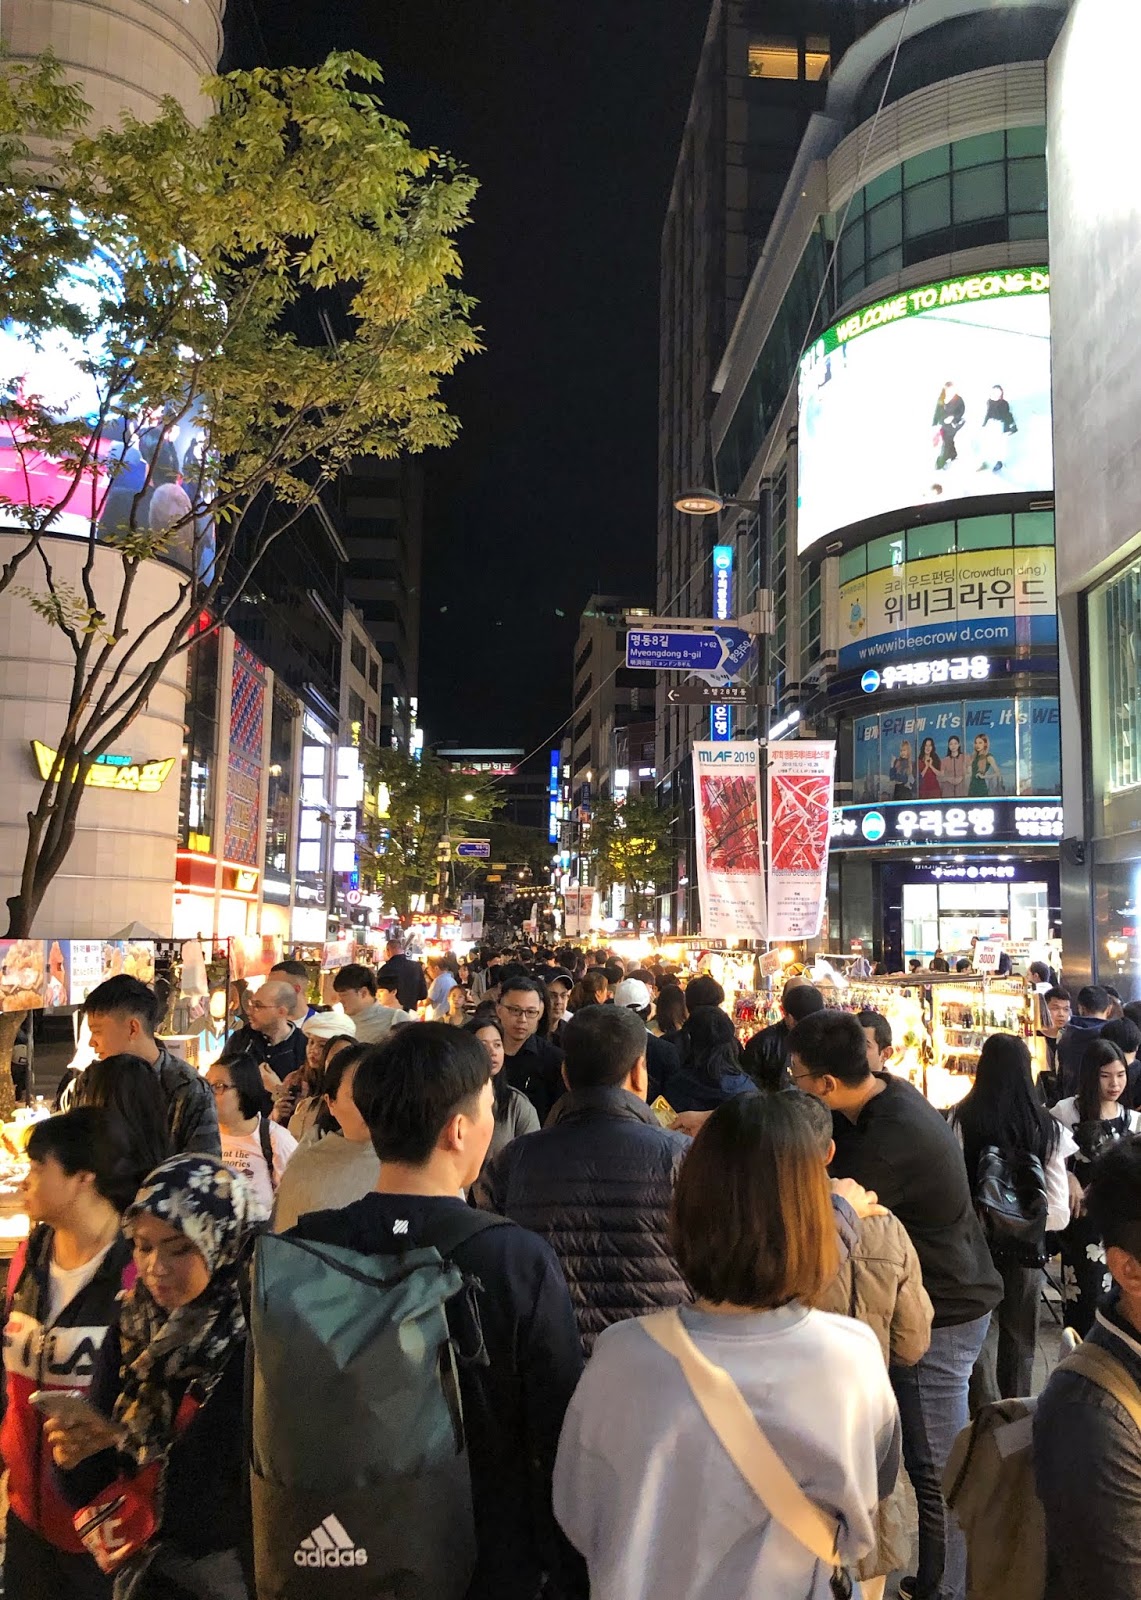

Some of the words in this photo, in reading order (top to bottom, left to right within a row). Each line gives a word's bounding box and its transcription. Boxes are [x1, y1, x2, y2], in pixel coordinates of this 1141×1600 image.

[836, 296, 908, 342] WELCOME
[909, 288, 937, 311] TO
[884, 569, 955, 594] 크라우드펀딩
[884, 580, 1048, 624] 위비크라우드
[630, 634, 669, 647] 명동8길
[630, 648, 682, 659] Myeongdong
[683, 650, 702, 659] 8-gil
[999, 709, 1028, 725] Its
[698, 750, 732, 763] MIAF
[734, 751, 756, 763] 2019
[895, 808, 995, 837] 우리은행
[979, 954, 996, 964] 3000
[235, 1149, 250, 1158] the
[293, 1547, 368, 1568] adidas
